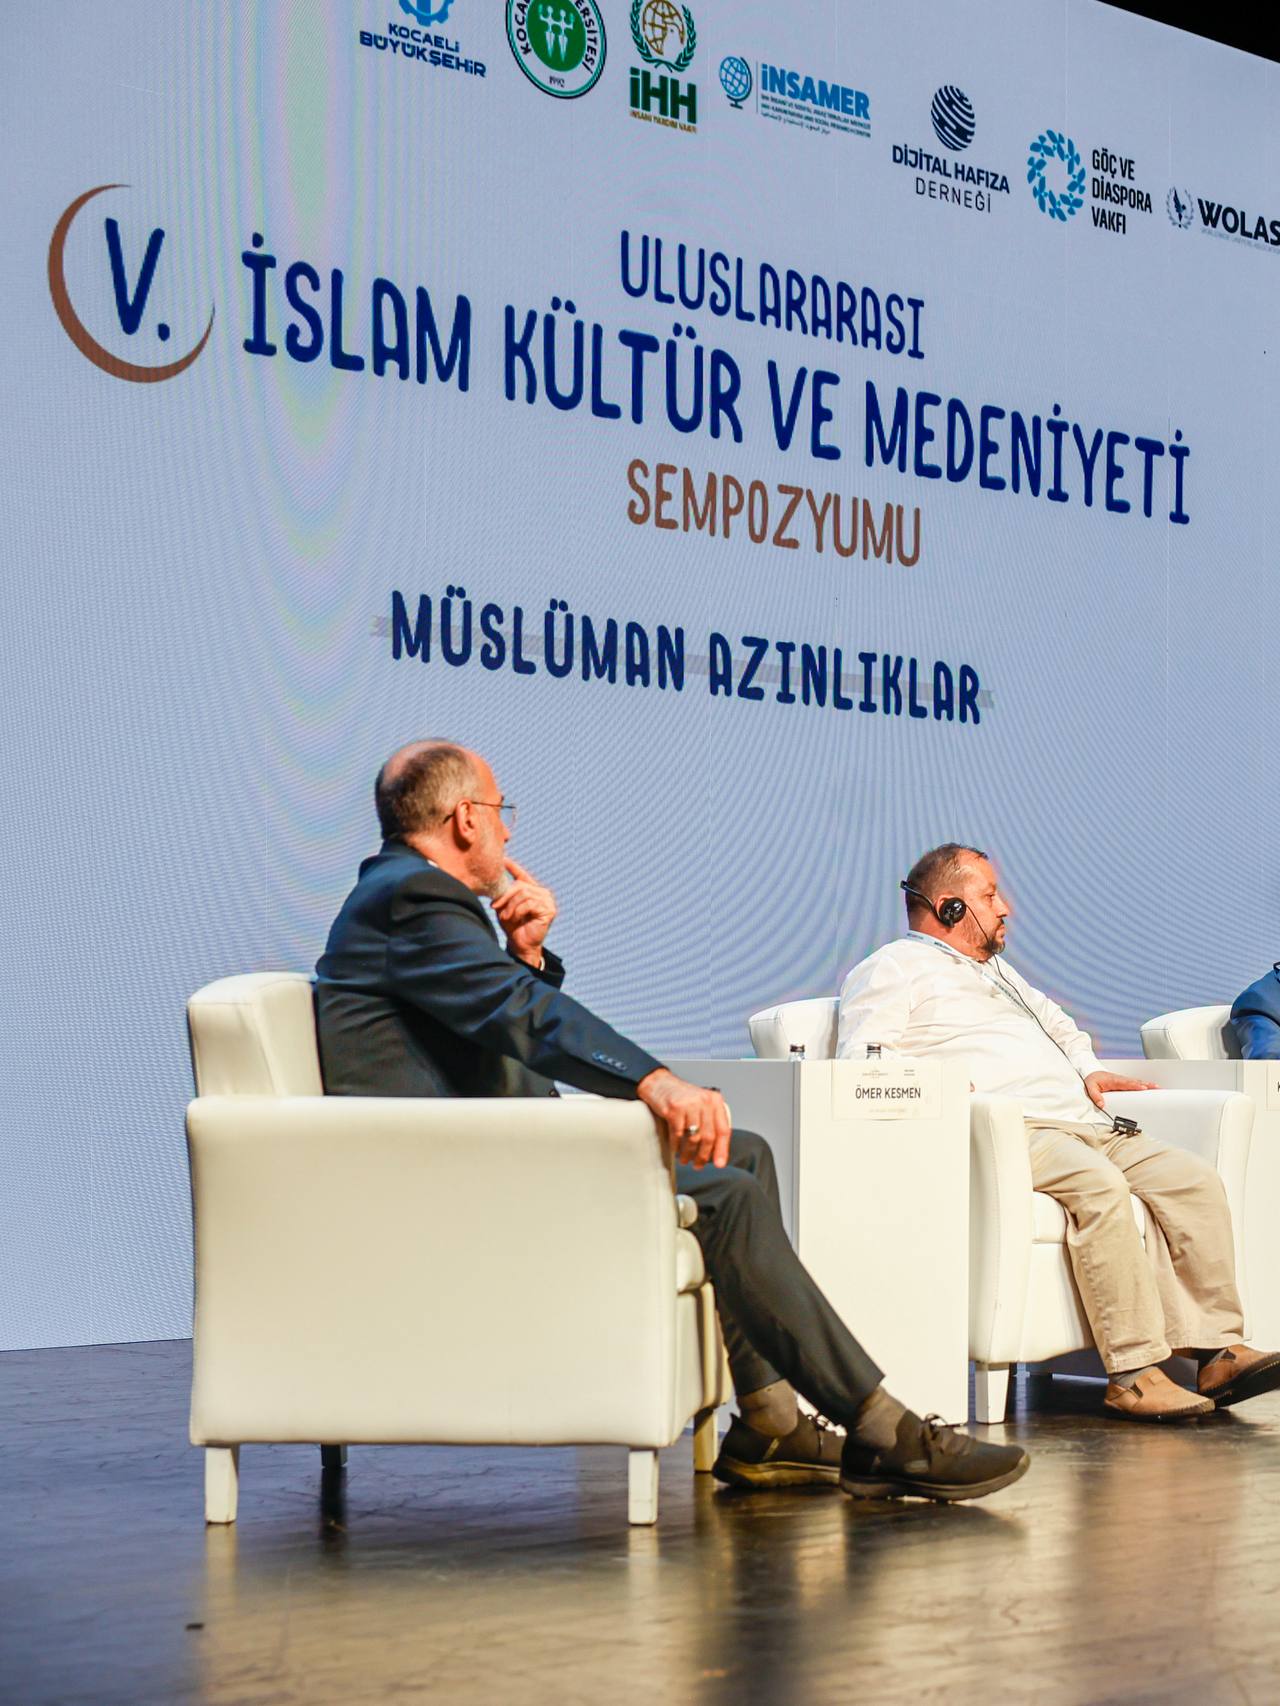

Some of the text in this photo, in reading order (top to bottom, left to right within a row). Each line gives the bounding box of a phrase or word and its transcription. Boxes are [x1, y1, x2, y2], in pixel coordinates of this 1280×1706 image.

[359, 30, 487, 78] BÜYÜKŞEHİR
[388, 22, 460, 53] KOCAELİ
[629, 66, 697, 125] İHH
[761, 63, 871, 121] İNSAMER
[892, 144, 1010, 194] DİJİTAL HAFIZA
[1092, 147, 1136, 181] GÖÇ VE
[915, 177, 991, 213] DERNEĞİ
[1092, 175, 1153, 214] DİASPORA
[1091, 205, 1127, 235] VAKFI
[105, 217, 171, 342] V.
[620, 230, 925, 360] ULUSLARARASI
[241, 231, 1191, 525] İSLAM KÜLTÜR VE MEDENİYETİ
[627, 458, 921, 567] SEMPOZYUMU
[391, 584, 981, 725] MÜSLÜMAN AZINLIKLAR
[855, 1084, 921, 1099] ÖMER KESMEN
